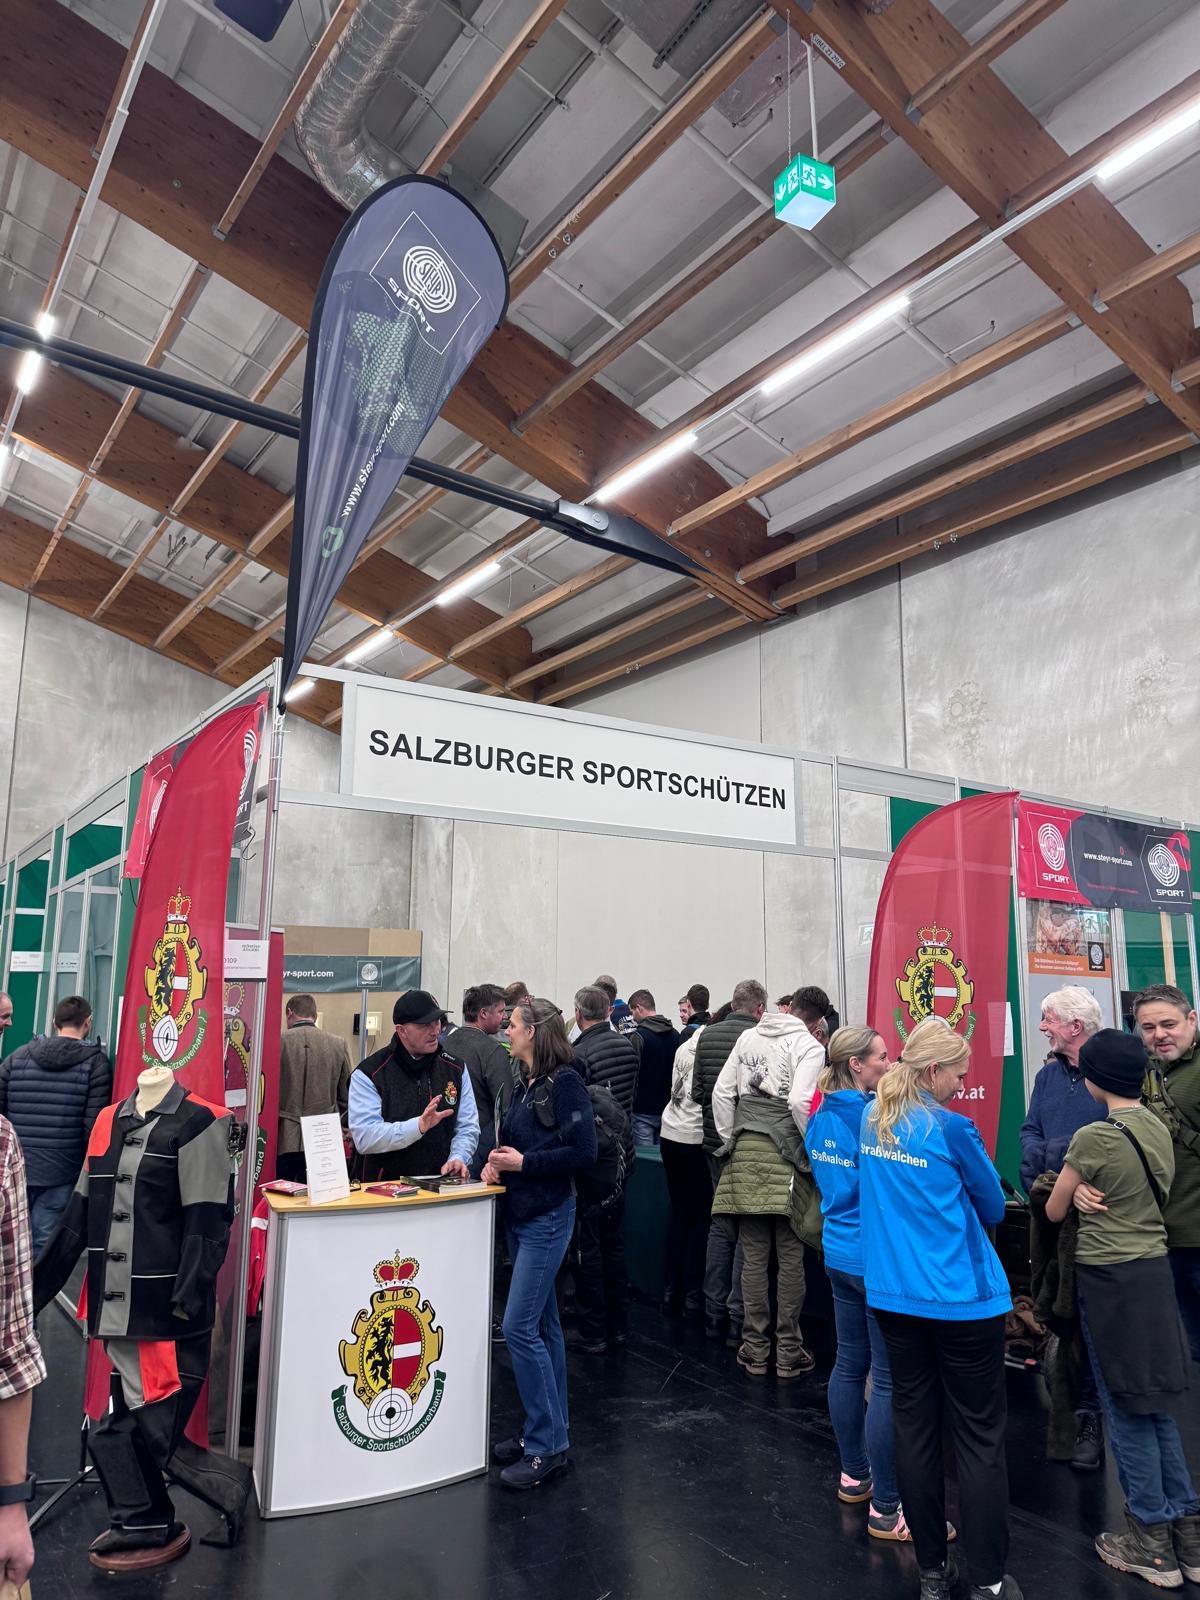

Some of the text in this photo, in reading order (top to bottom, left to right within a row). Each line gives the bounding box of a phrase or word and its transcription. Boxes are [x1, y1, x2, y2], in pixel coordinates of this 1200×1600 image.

[387, 277, 436, 333] SPORT
[341, 401, 406, 517] www.steyr-sport.com
[368, 729, 786, 811] SALZBURGER SPORTSCHÜTZEN
[1042, 872, 1070, 885] SPORT
[1155, 888, 1185, 897] SPORT
[282, 969, 334, 979] yr-sport.com
[336, 1388, 443, 1452] Salzburger Sportschützenverband
